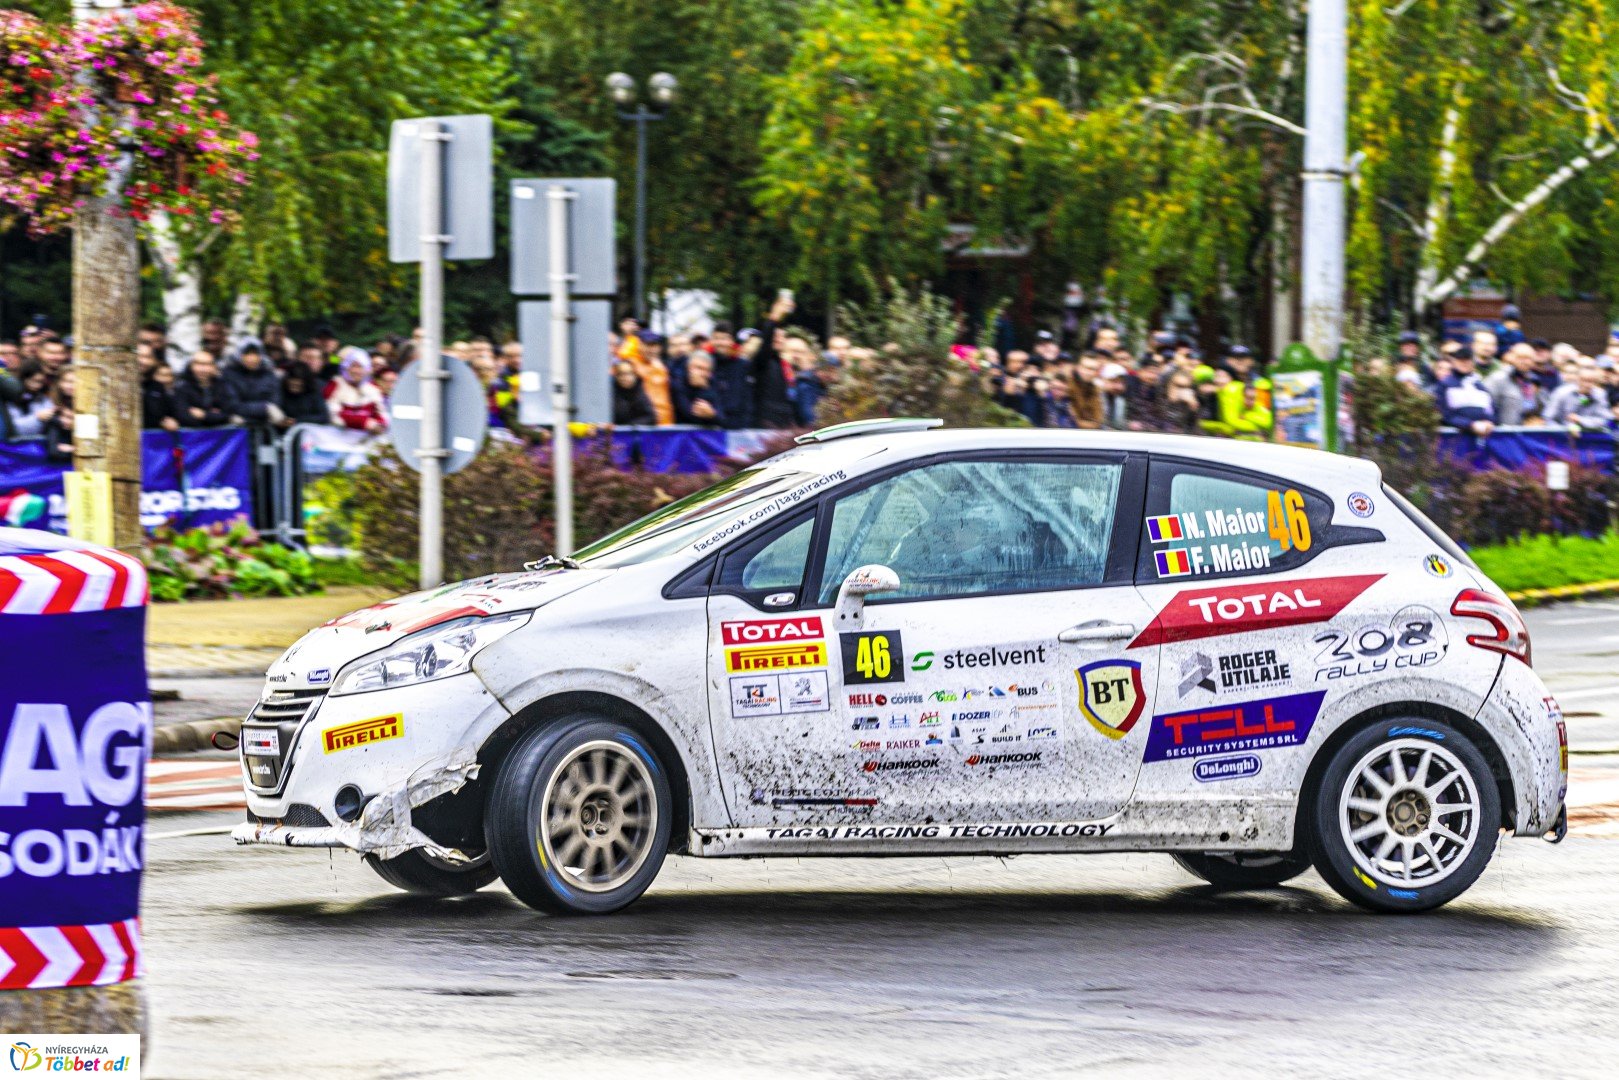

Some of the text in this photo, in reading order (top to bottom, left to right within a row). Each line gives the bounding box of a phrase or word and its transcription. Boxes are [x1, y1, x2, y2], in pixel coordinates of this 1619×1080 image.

[693, 469, 847, 552] facebook.com/tagairacing
[1267, 489, 1312, 552] 46
[1182, 508, 1266, 540] N. Maior
[1190, 542, 1271, 575] F. Maior
[1189, 589, 1322, 623] TOTAL
[724, 621, 819, 641] TOTAL
[1313, 619, 1437, 664] 208
[731, 645, 819, 670] PIRELLI
[856, 635, 891, 679] 46
[943, 645, 1046, 669] steelvent
[1219, 649, 1277, 671] ROGER
[1395, 651, 1438, 668] CUP
[1221, 664, 1291, 688] UTILAJE
[849, 693, 873, 705] HELL
[891, 694, 923, 704] COFFEE
[1017, 687, 1038, 697] BUS
[1091, 678, 1129, 704] BT
[959, 711, 991, 721] DOZER
[1164, 705, 1296, 745] TELL
[326, 716, 397, 751] PIRELLI
[860, 740, 880, 748] Delta
[886, 740, 921, 750] RAIKER
[992, 735, 1013, 743] BUILD
[1166, 734, 1298, 757] SECURITY SYSTEMS SRL
[1200, 759, 1255, 775] DeLonghi
[766, 824, 1114, 838] TAGAI RACING TECHNOLOGY
